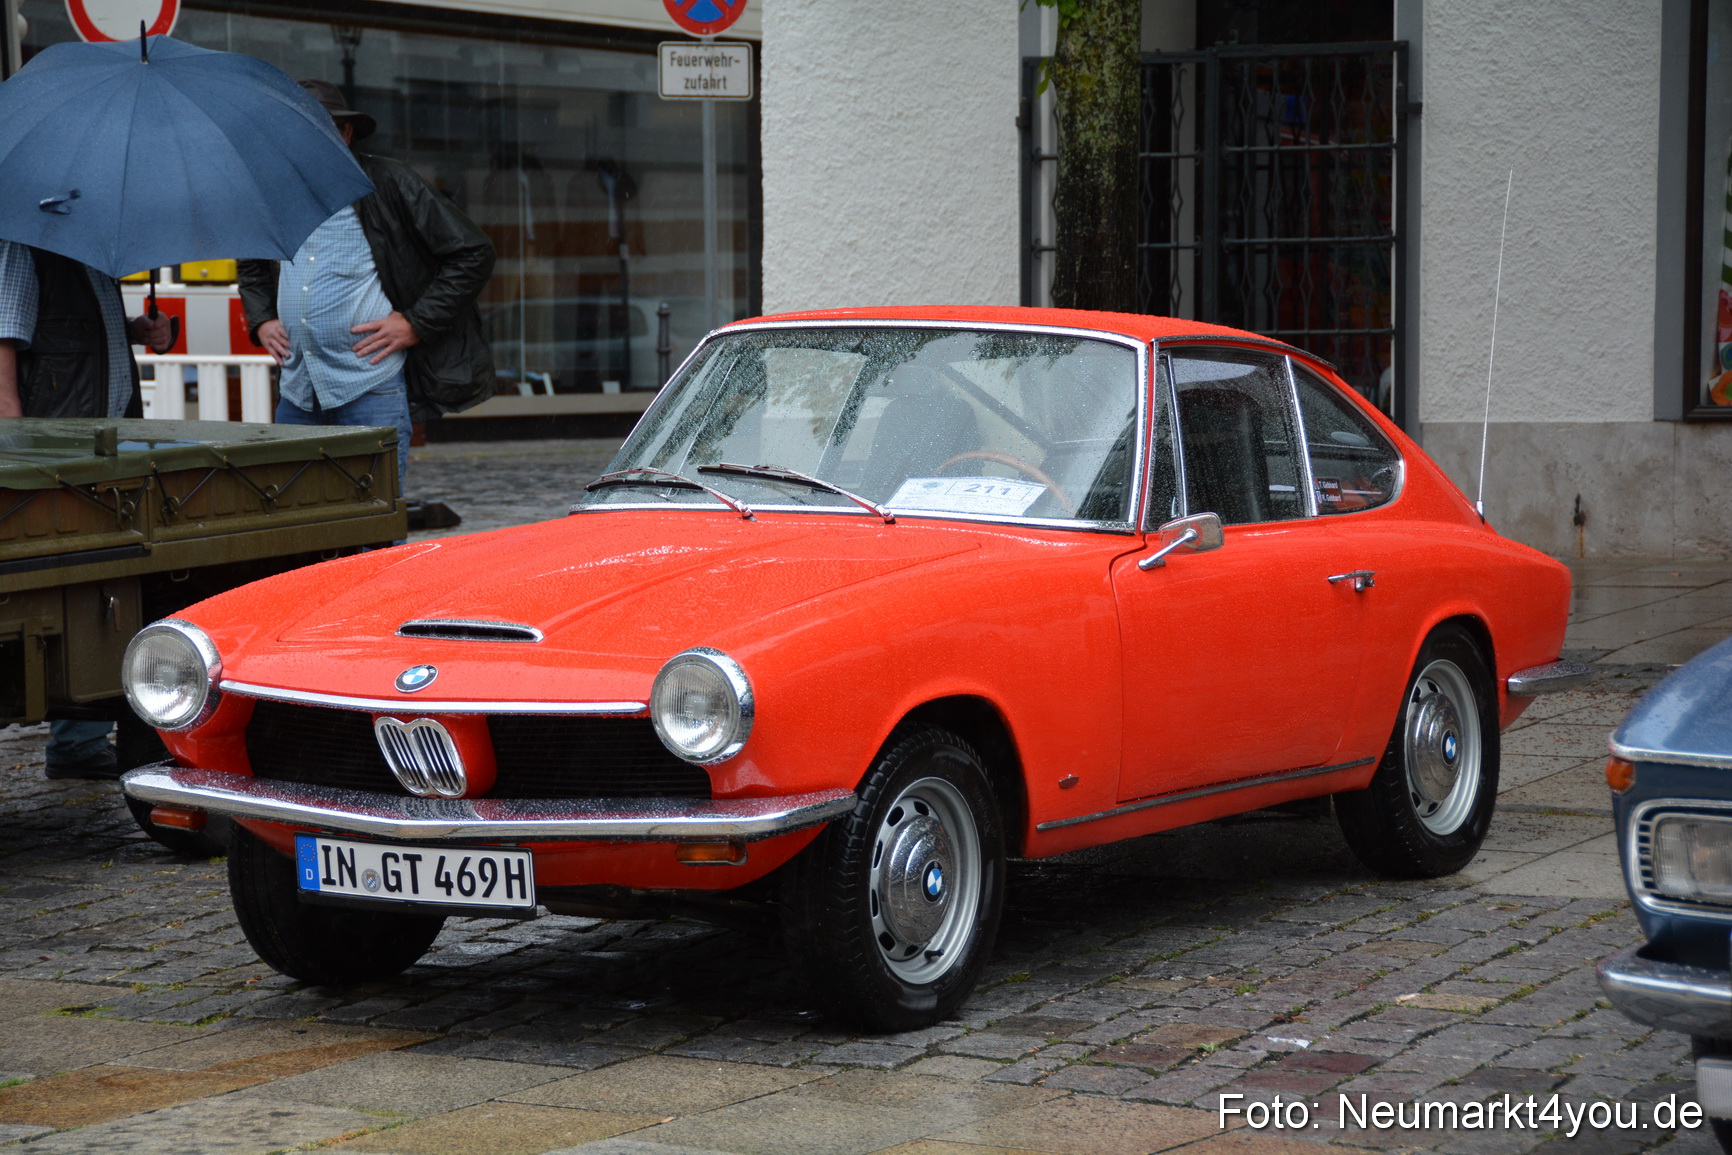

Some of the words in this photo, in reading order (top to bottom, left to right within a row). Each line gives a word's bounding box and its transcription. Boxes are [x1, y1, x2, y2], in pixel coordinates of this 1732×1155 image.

[670, 51, 740, 67] Feuerwehr-
[684, 74, 727, 90] zufahrt
[963, 483, 1011, 496] 211
[305, 868, 314, 880] D
[321, 845, 357, 888] IN
[381, 851, 422, 894] GT
[434, 855, 527, 899] 469H
